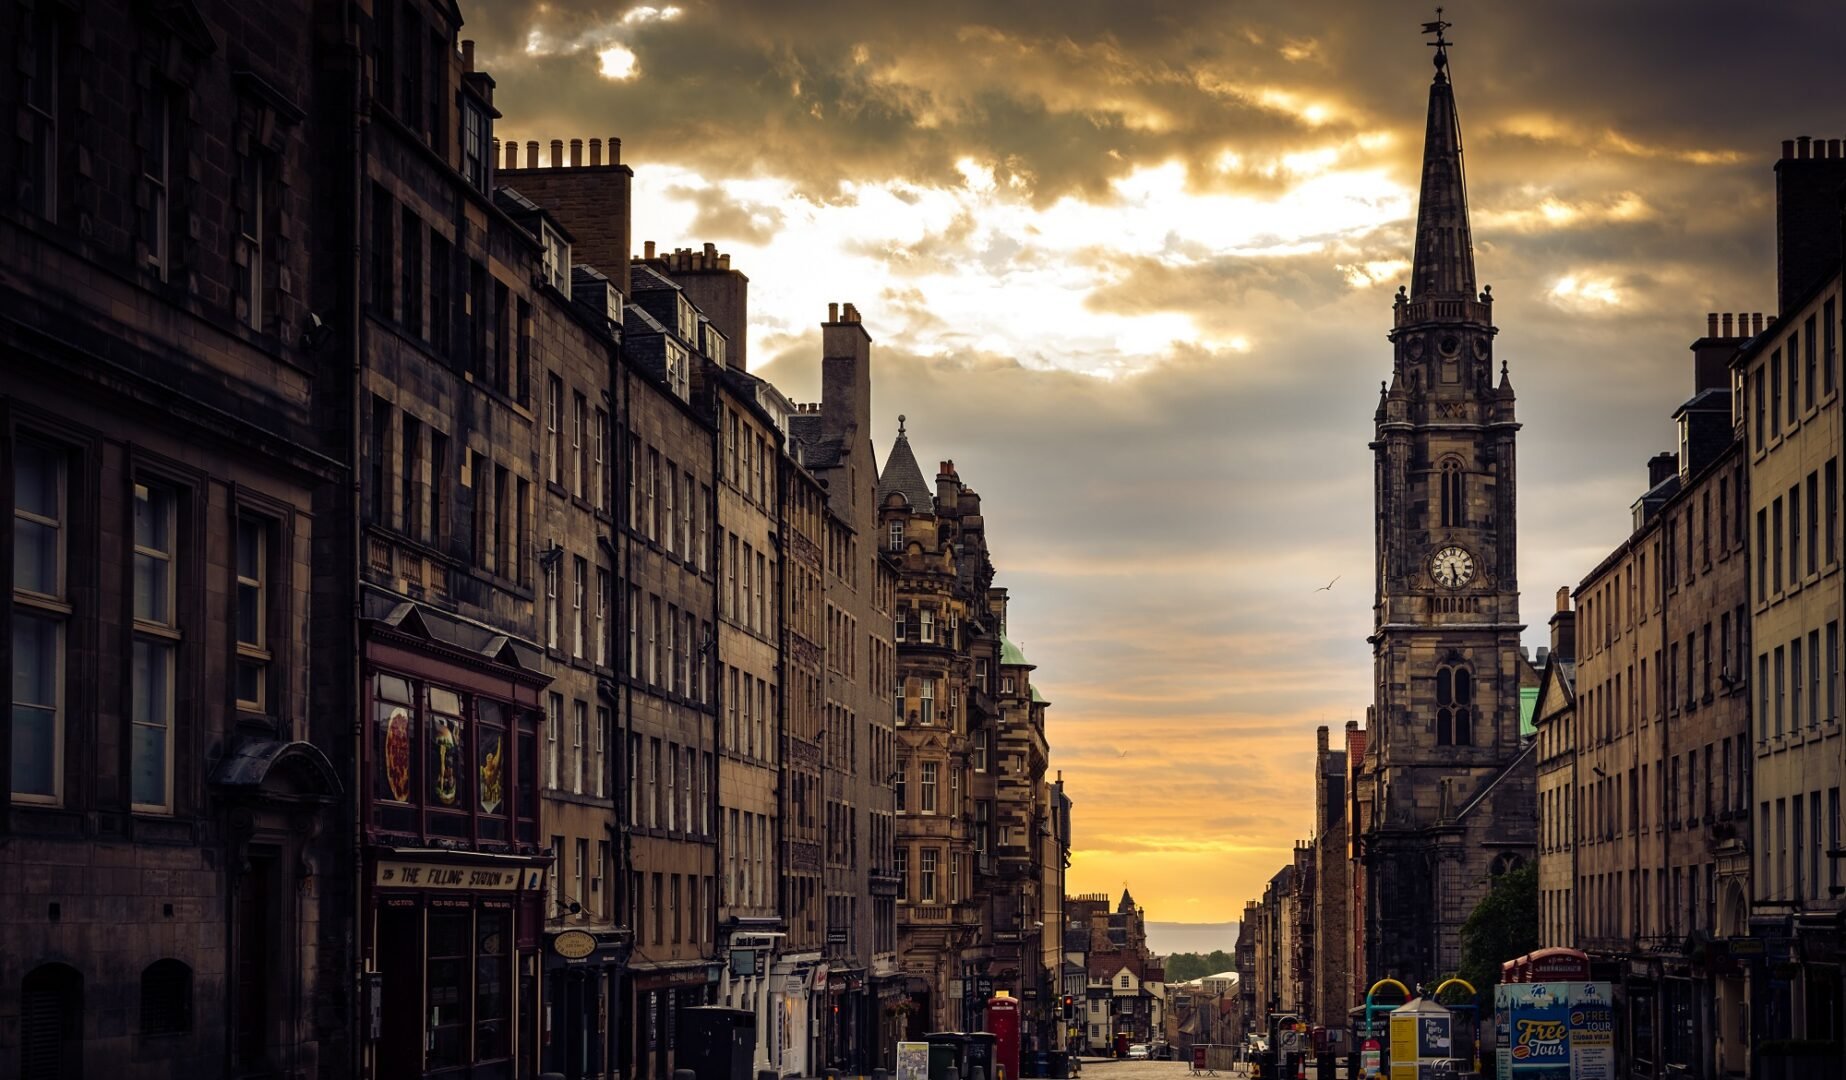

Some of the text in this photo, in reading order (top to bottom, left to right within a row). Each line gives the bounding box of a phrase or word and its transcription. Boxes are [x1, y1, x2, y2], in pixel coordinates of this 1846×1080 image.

[401, 867, 421, 884] THE
[427, 869, 464, 885] FILLING
[469, 871, 502, 885] STATION
[557, 945, 593, 956] TRATTORIA
[1585, 1011, 1611, 1021] FREE
[1516, 1019, 1568, 1045] Free
[1586, 1022, 1612, 1031] TOUR
[1528, 1039, 1566, 1056] Tour
